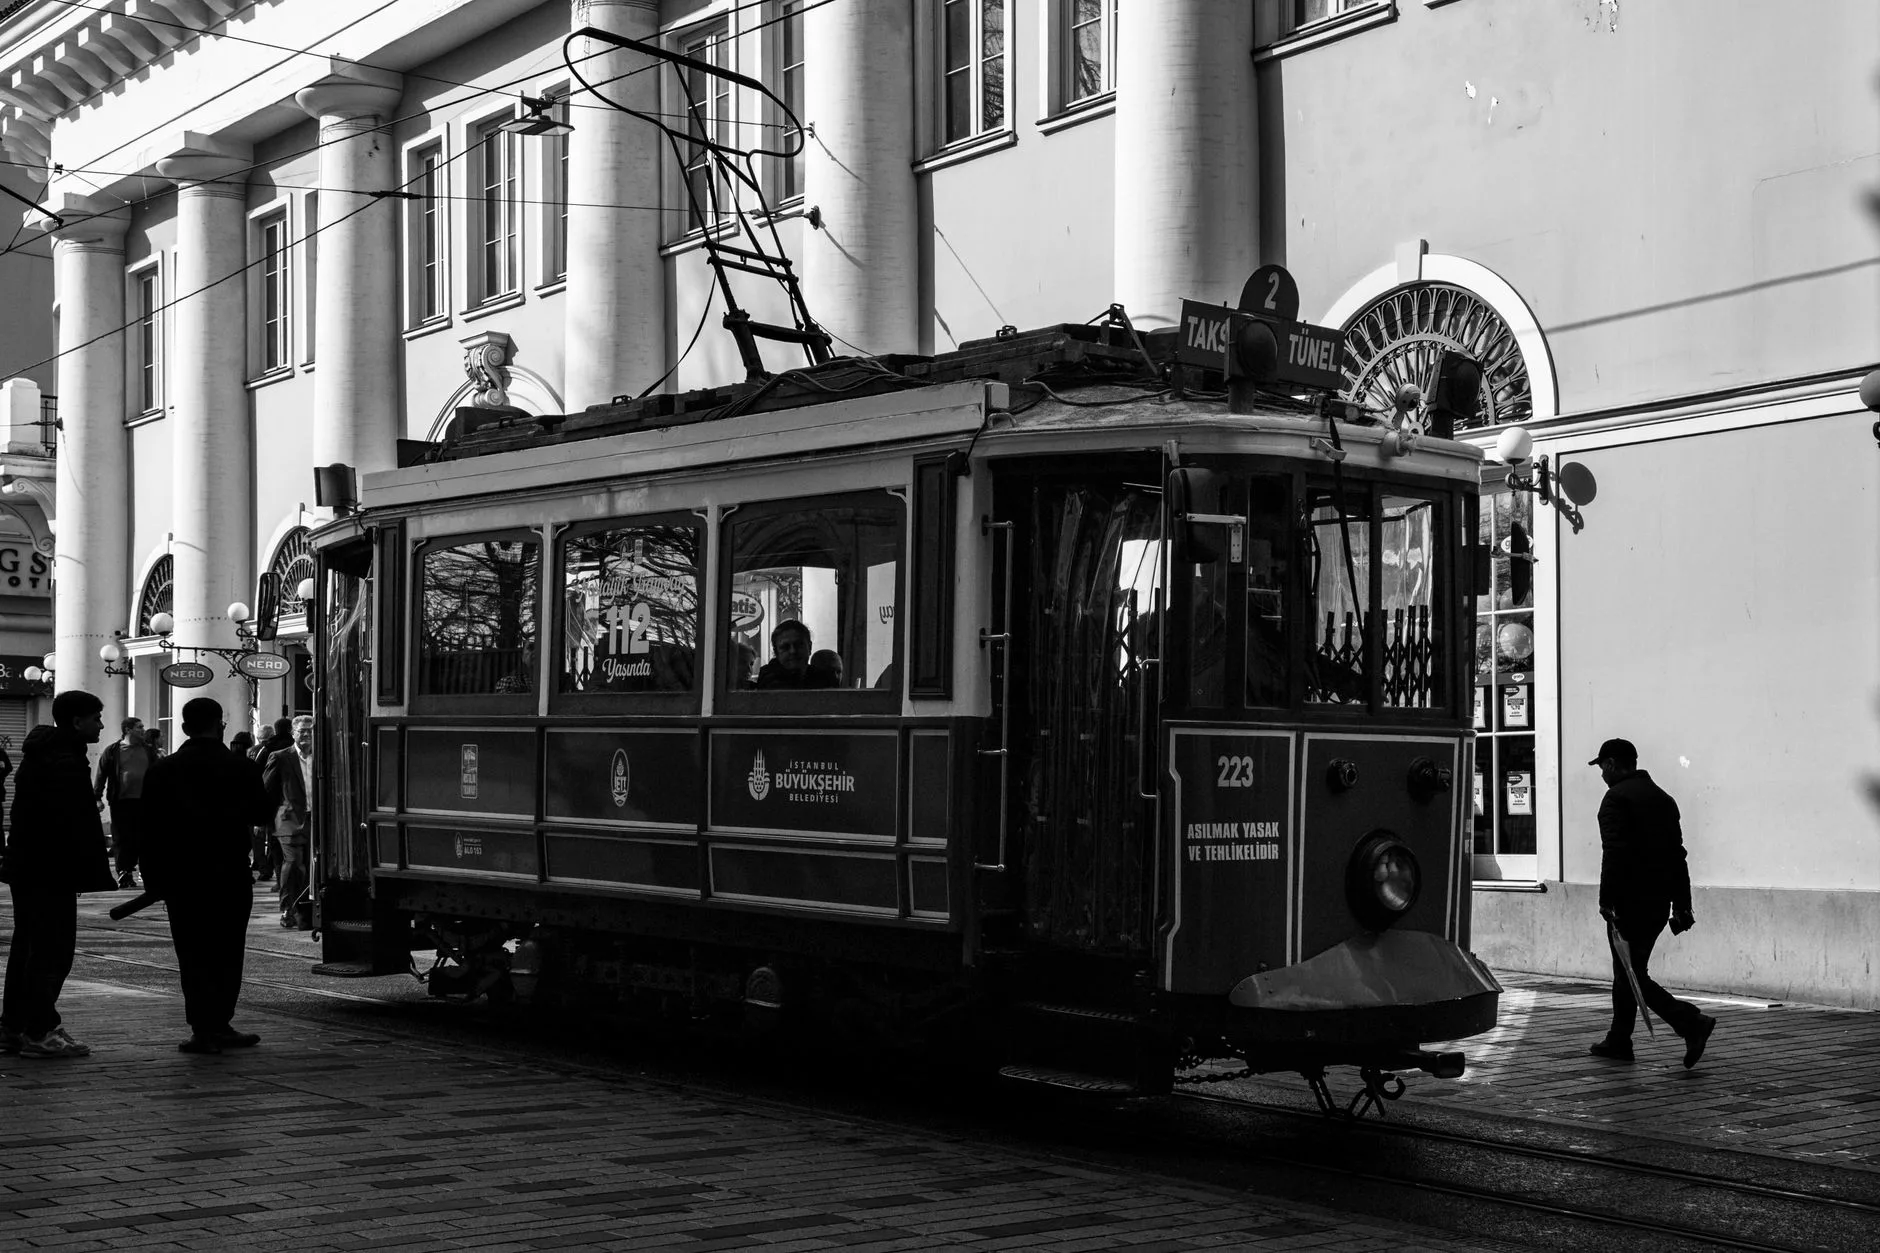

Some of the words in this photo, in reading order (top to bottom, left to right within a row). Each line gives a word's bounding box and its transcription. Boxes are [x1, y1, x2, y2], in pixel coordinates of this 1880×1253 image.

[1264, 271, 1280, 310] 2
[1187, 315, 1229, 353] TAKS
[1289, 328, 1337, 372] TÜNEL
[732, 598, 757, 614] atis
[606, 602, 651, 655] 112
[170, 670, 205, 678] NERO
[247, 660, 282, 669] NERO
[602, 658, 651, 683] Yaşında
[775, 769, 855, 795] BÜYÜKŞEHİR
[1217, 755, 1254, 787] 223
[789, 792, 839, 803] BELEDİYESİ
[1187, 823, 1239, 839] ASILMAK
[1242, 822, 1279, 838] YASAK
[1188, 845, 1201, 861] VE
[1204, 841, 1279, 860] TEHLİKELİDİR
